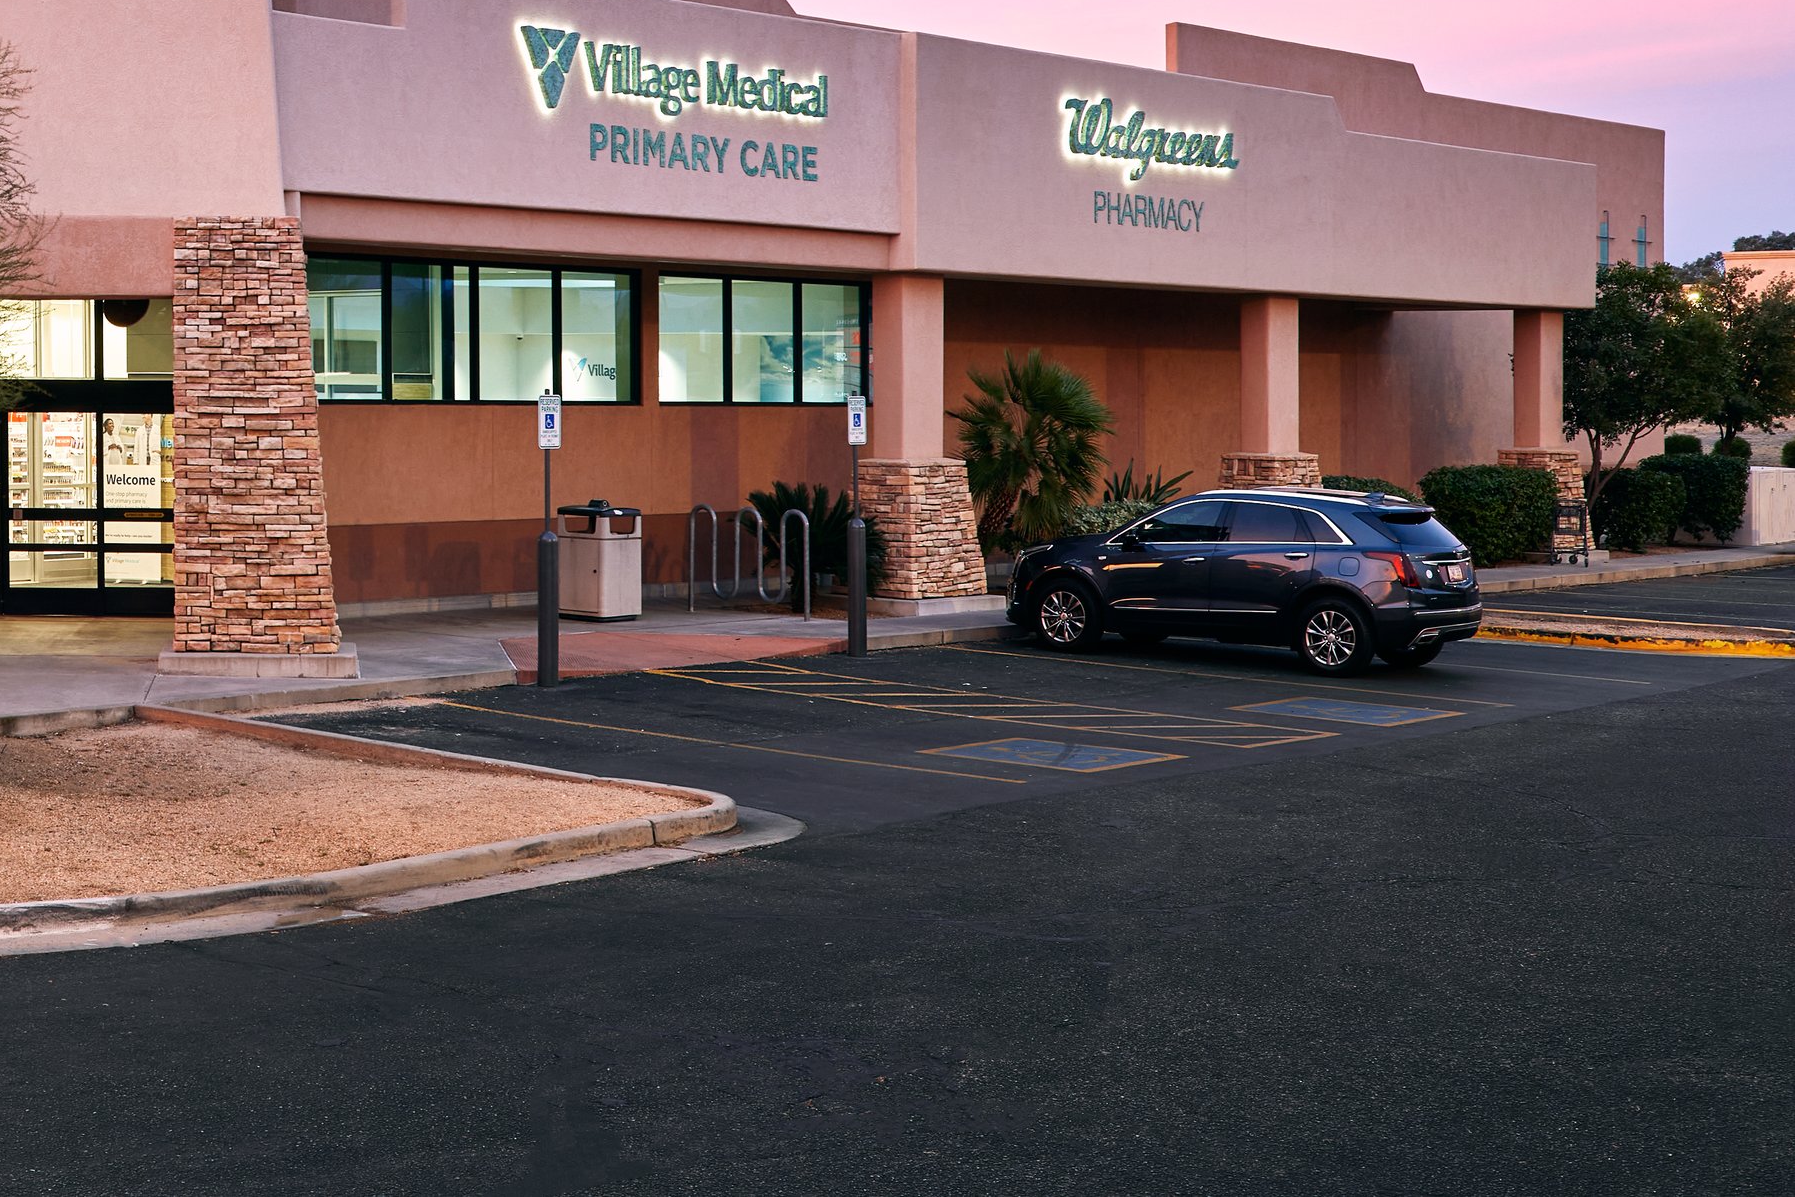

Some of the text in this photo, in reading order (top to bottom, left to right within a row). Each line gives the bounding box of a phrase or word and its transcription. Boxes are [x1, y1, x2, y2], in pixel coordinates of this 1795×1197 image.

[583, 40, 829, 118] Village Medical
[589, 123, 819, 182] PRIMARY CARE
[1065, 97, 1240, 181] Walgreens
[1093, 190, 1204, 233] PHARMACY
[106, 473, 156, 486] Welcome
